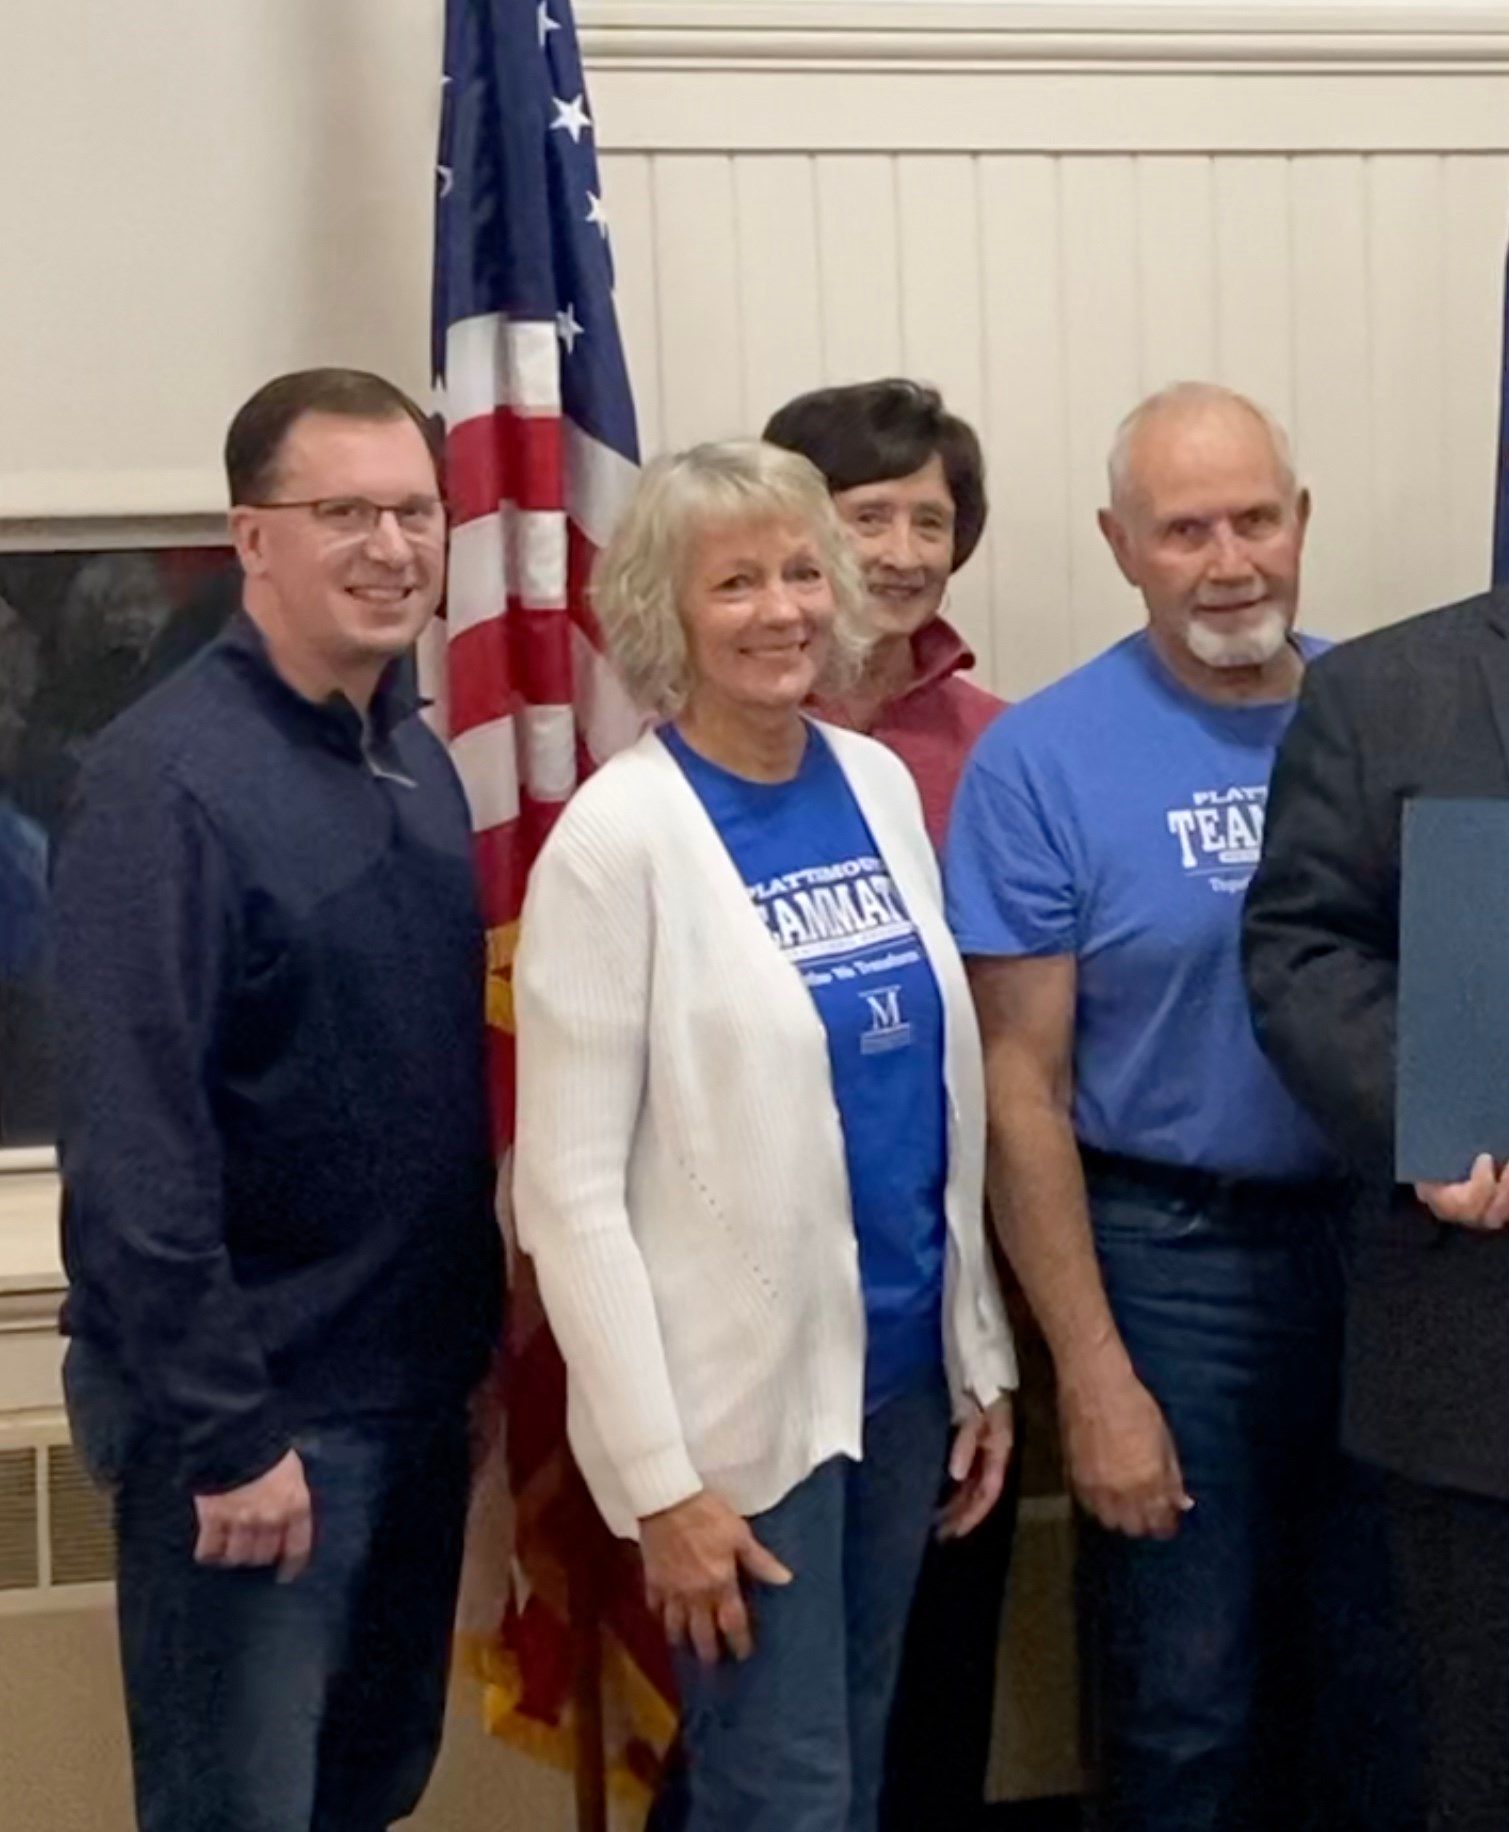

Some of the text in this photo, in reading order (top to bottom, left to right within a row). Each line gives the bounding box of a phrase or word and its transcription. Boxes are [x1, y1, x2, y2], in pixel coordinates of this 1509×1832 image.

[1193, 785, 1267, 806] PLAT
[764, 874, 905, 947] AMMAT
[858, 984, 901, 1032] M
